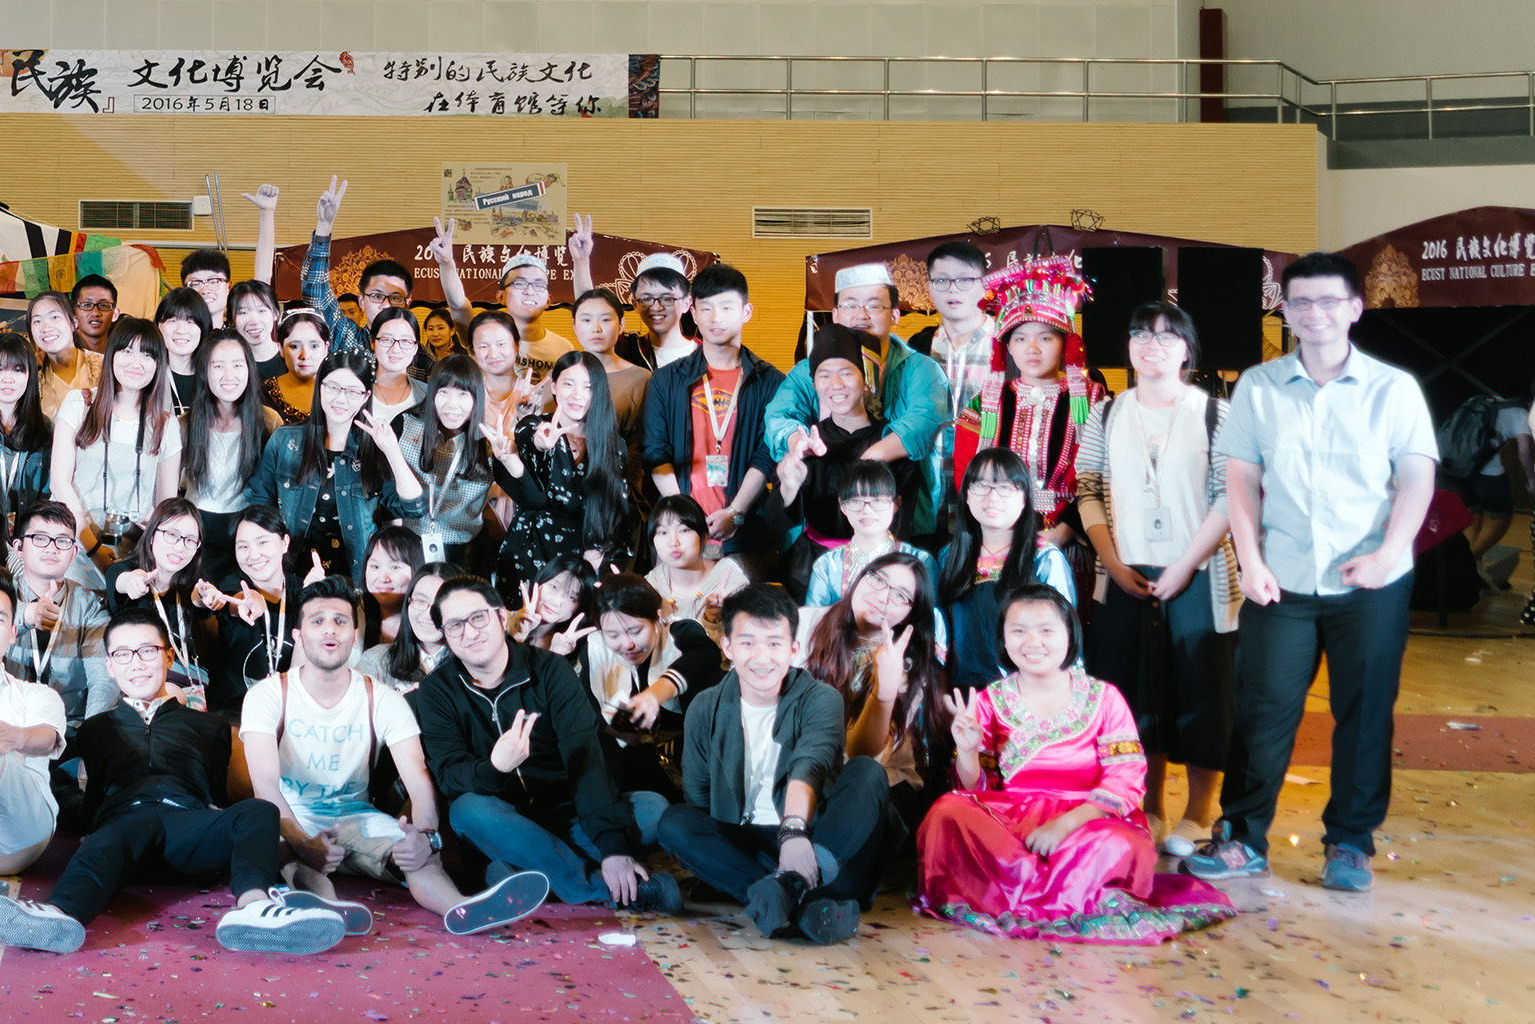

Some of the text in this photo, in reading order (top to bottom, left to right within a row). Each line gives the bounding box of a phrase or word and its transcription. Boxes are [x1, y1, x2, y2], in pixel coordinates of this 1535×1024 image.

[127, 54, 342, 93] 文化博览会
[383, 56, 592, 83] 特别的民族文化
[142, 95, 270, 113] 2016年5月18日
[482, 193, 510, 206] Русский
[1421, 239, 1448, 260] 2016
[414, 267, 440, 279] ECUS
[1421, 267, 1445, 281] ECUST
[1449, 265, 1487, 279] NATIONAL
[1490, 263, 1525, 277] CULTURE
[288, 718, 364, 743] CATCH
[307, 752, 340, 771] ME
